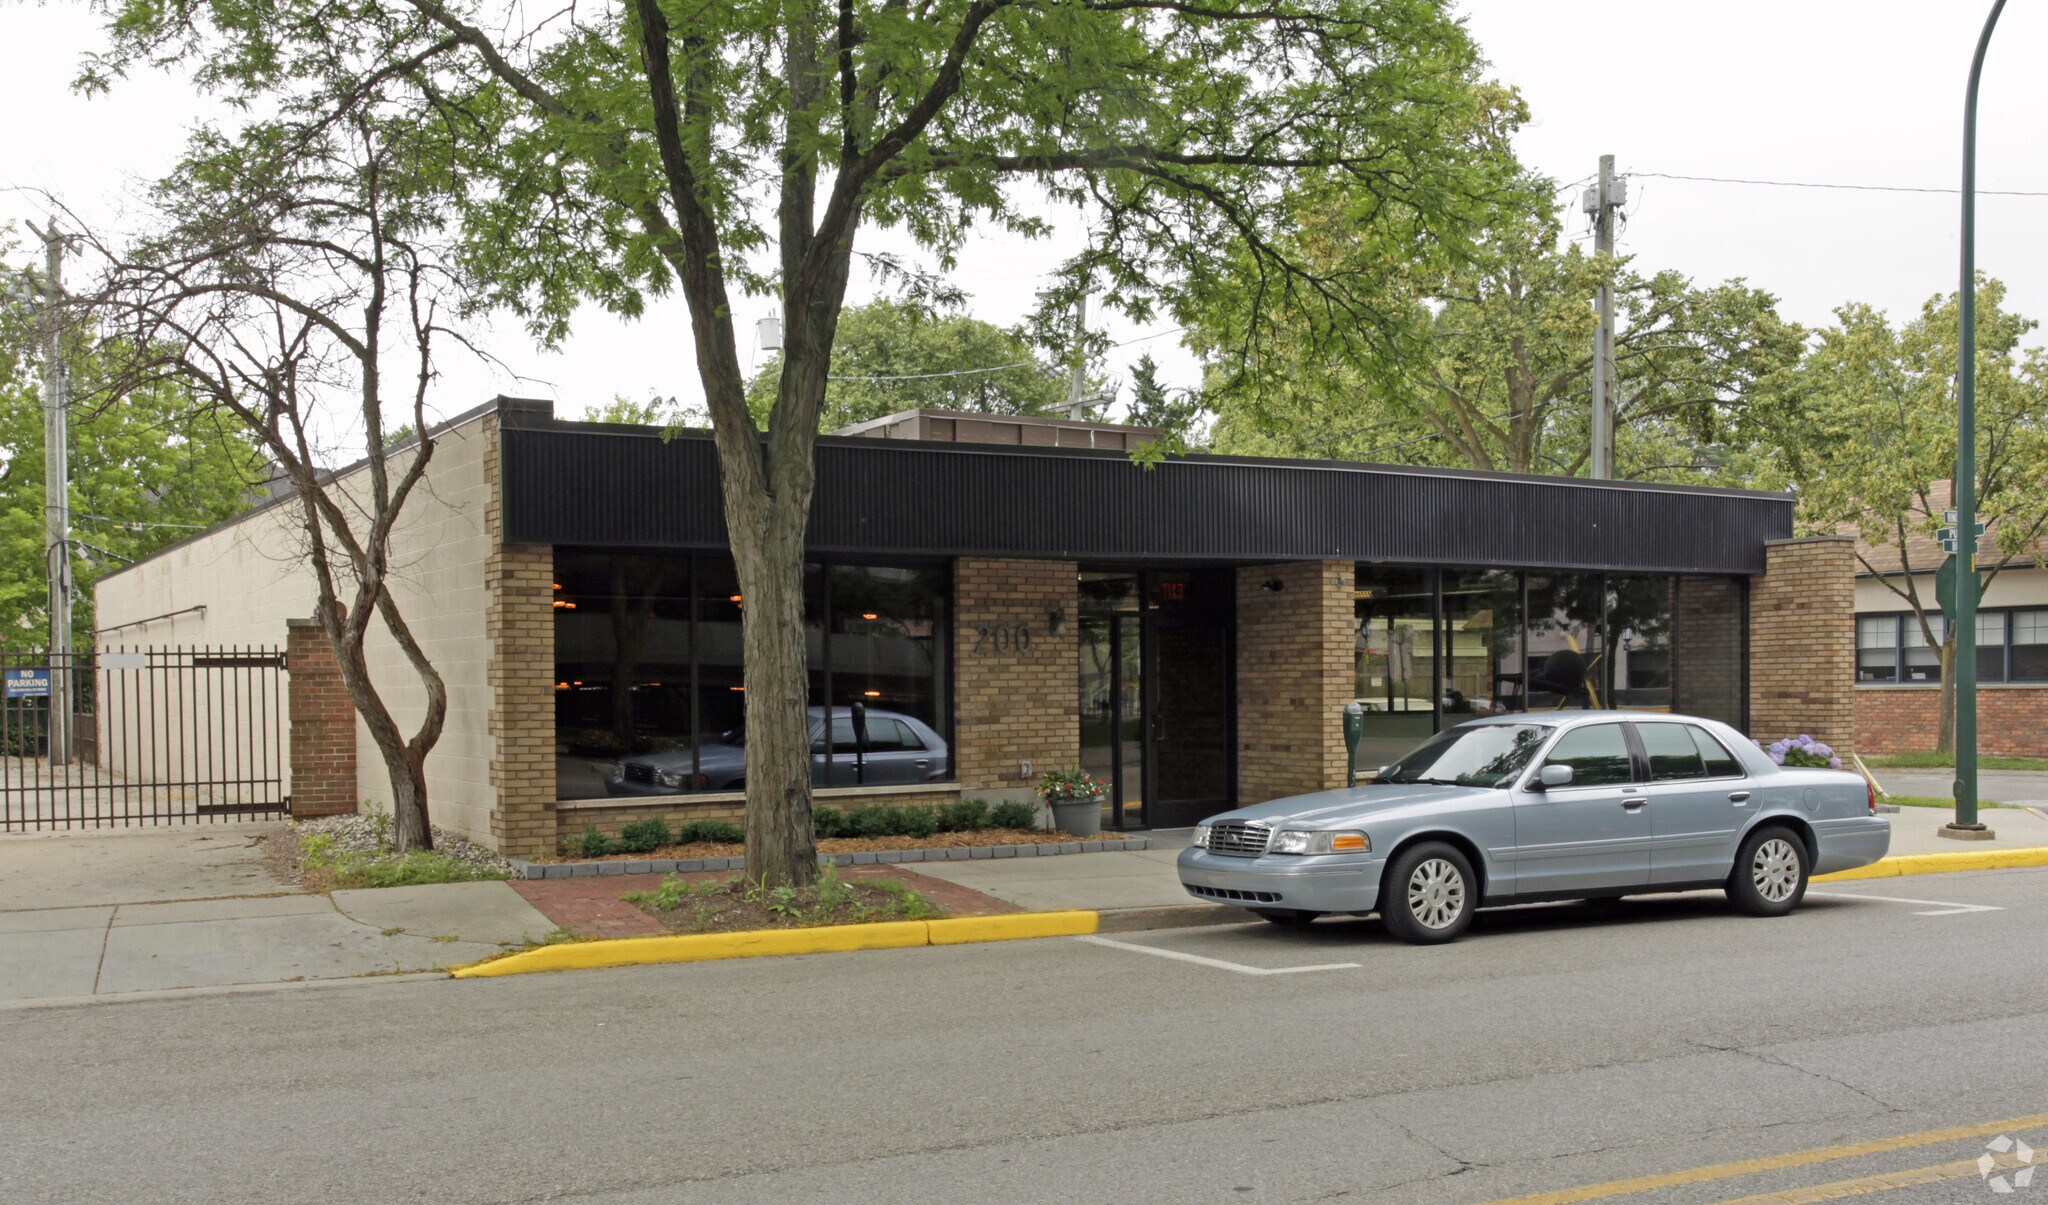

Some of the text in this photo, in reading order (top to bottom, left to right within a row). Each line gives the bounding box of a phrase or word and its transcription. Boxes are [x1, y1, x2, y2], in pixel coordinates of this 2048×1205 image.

[974, 624, 1030, 656] 200
[20, 670, 34, 678] NO
[7, 679, 48, 687] PARKING
